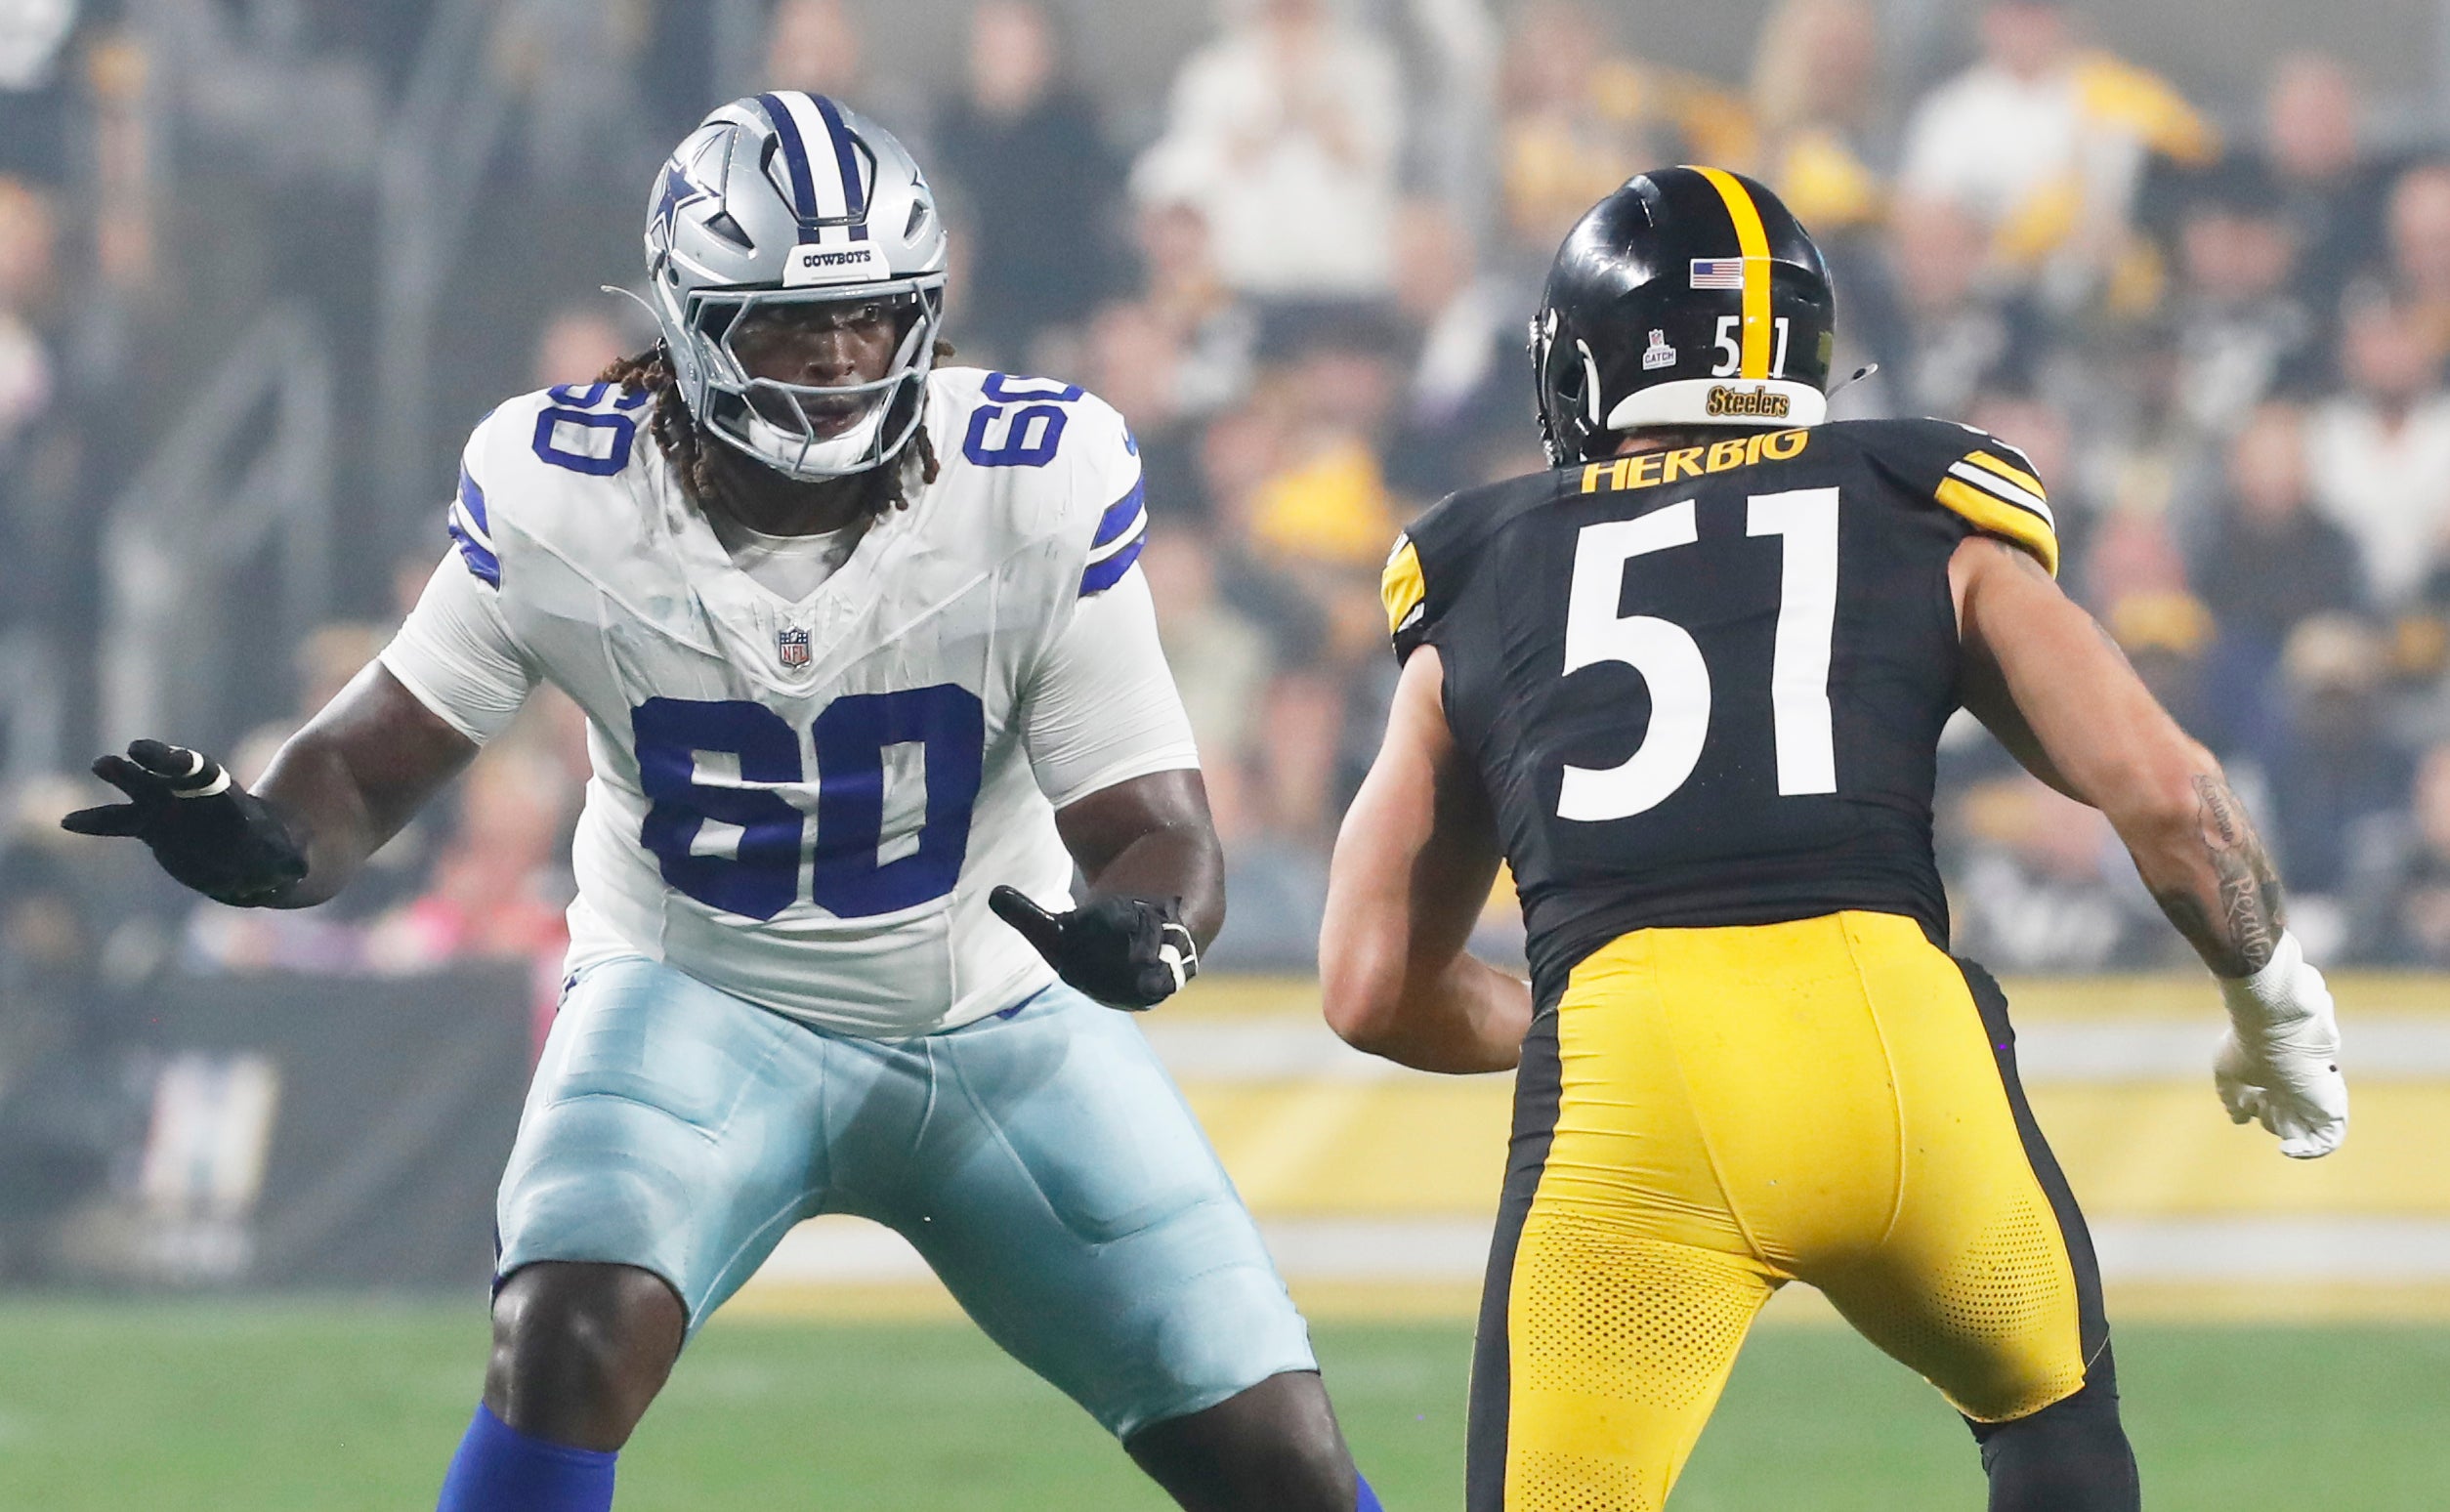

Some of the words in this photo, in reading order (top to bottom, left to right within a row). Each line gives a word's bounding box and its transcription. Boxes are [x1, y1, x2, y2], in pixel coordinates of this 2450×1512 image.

[803, 250, 871, 268] COWBOYS
[1644, 351, 1674, 363] CATCH
[1706, 385, 1790, 418] Steelers
[1581, 427, 1810, 494] HERBIG
[783, 646, 809, 661] NFL
[1556, 486, 1839, 821] 51
[630, 684, 986, 921] 60
